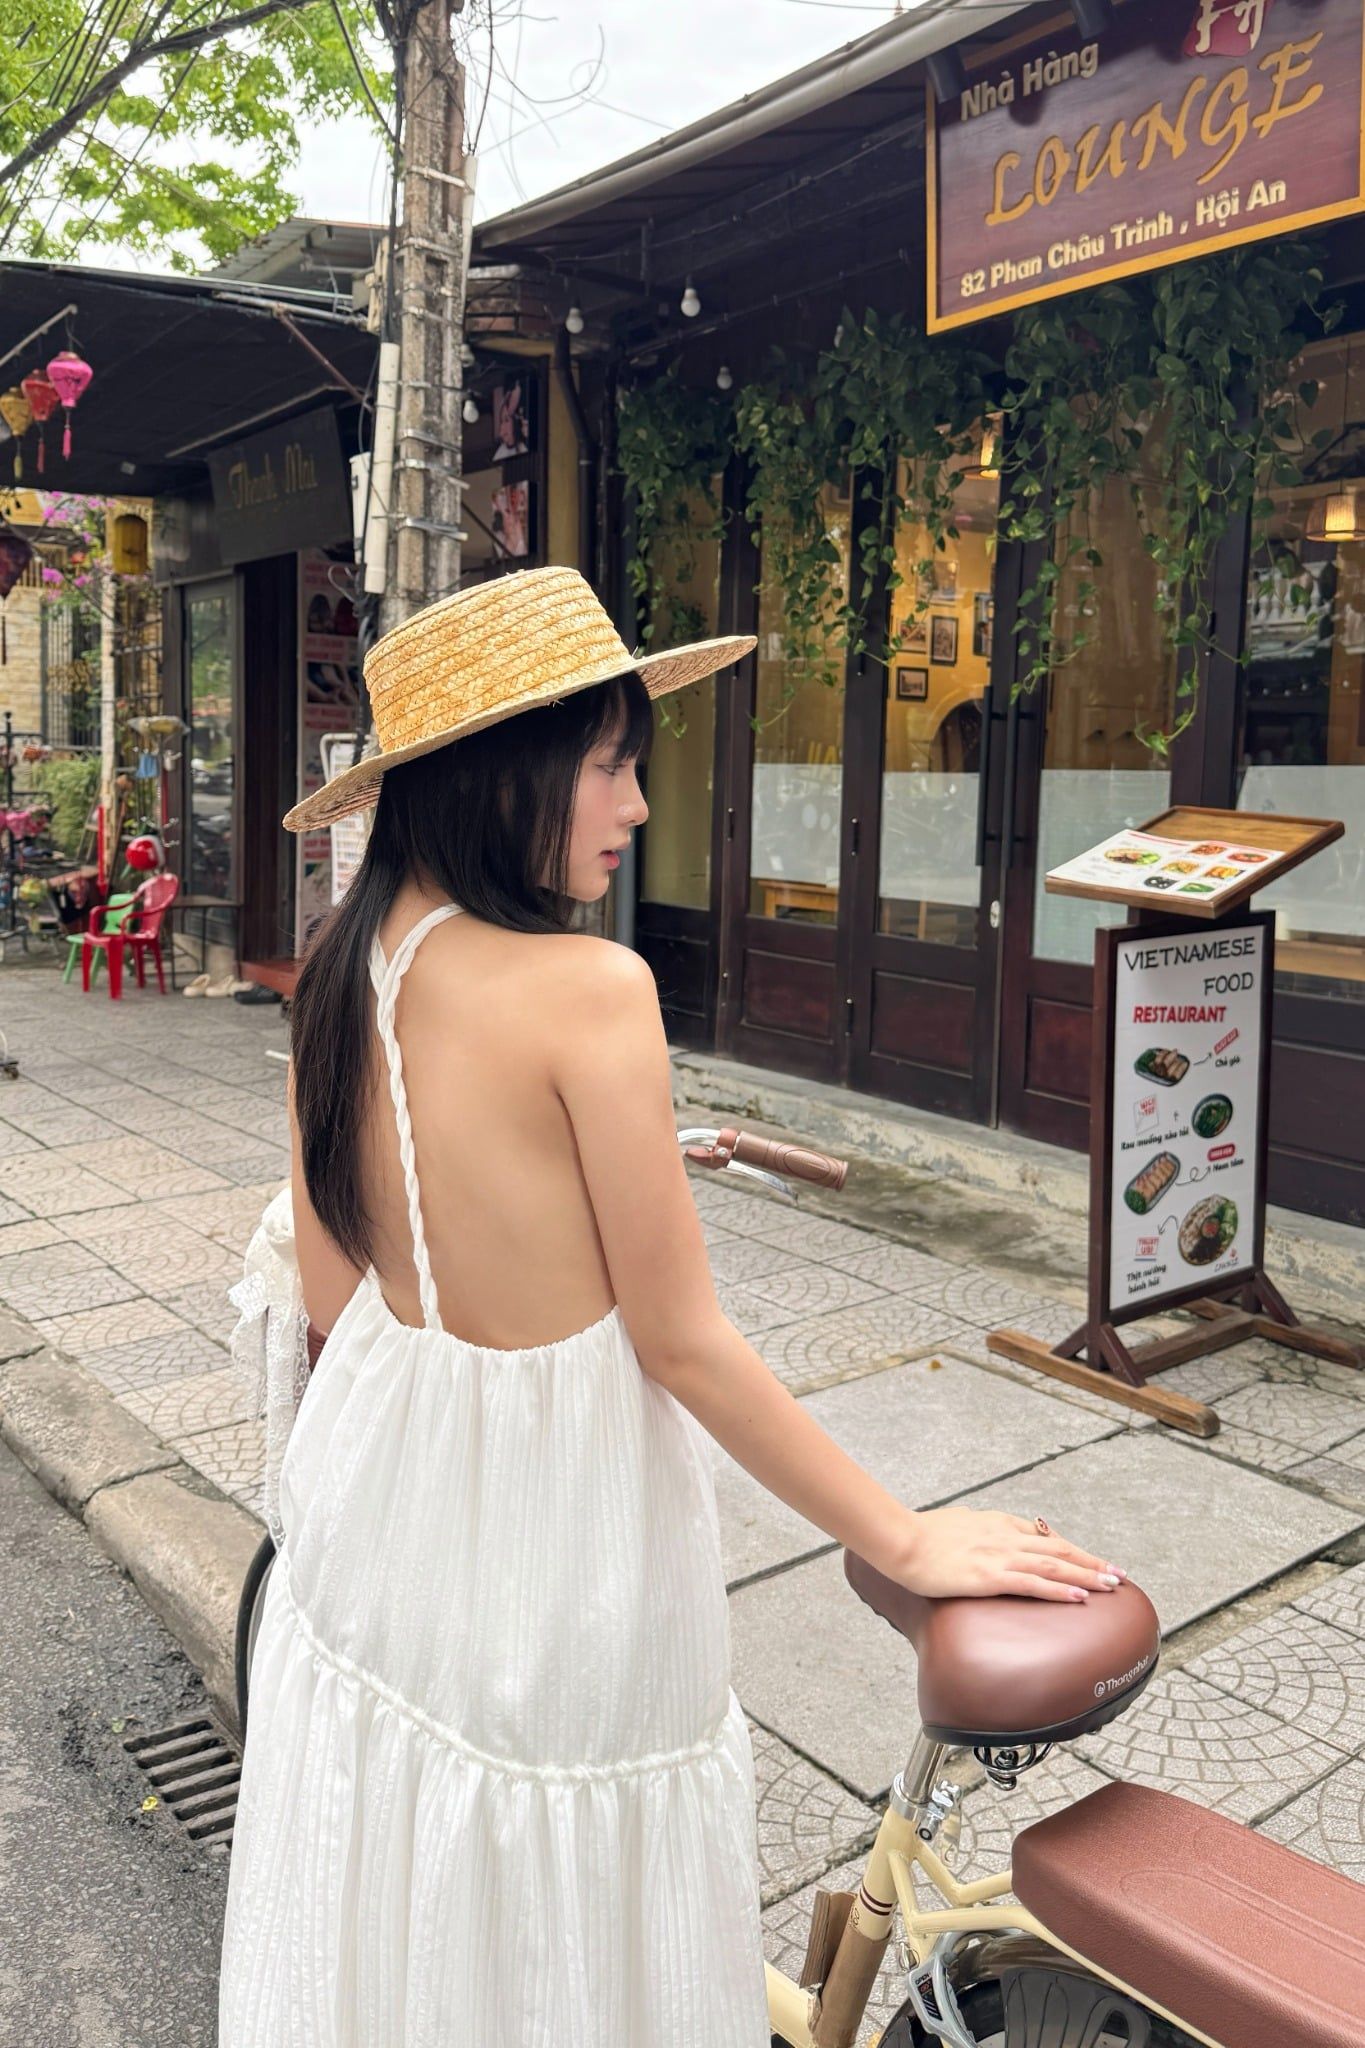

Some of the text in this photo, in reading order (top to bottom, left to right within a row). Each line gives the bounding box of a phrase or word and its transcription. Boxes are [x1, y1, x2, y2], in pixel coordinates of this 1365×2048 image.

[961, 43, 1099, 121] Nhà Hàng
[985, 31, 1325, 226] LOUNGE
[961, 269, 986, 297] 82
[990, 255, 1042, 289] Phan
[1048, 233, 1105, 269] Châu
[1196, 187, 1240, 228] Hội
[1245, 179, 1286, 212] An
[1124, 936, 1256, 971] VIETNAMESE
[1203, 972, 1254, 996] FOOD
[1132, 1005, 1227, 1023] RESTAURANT
